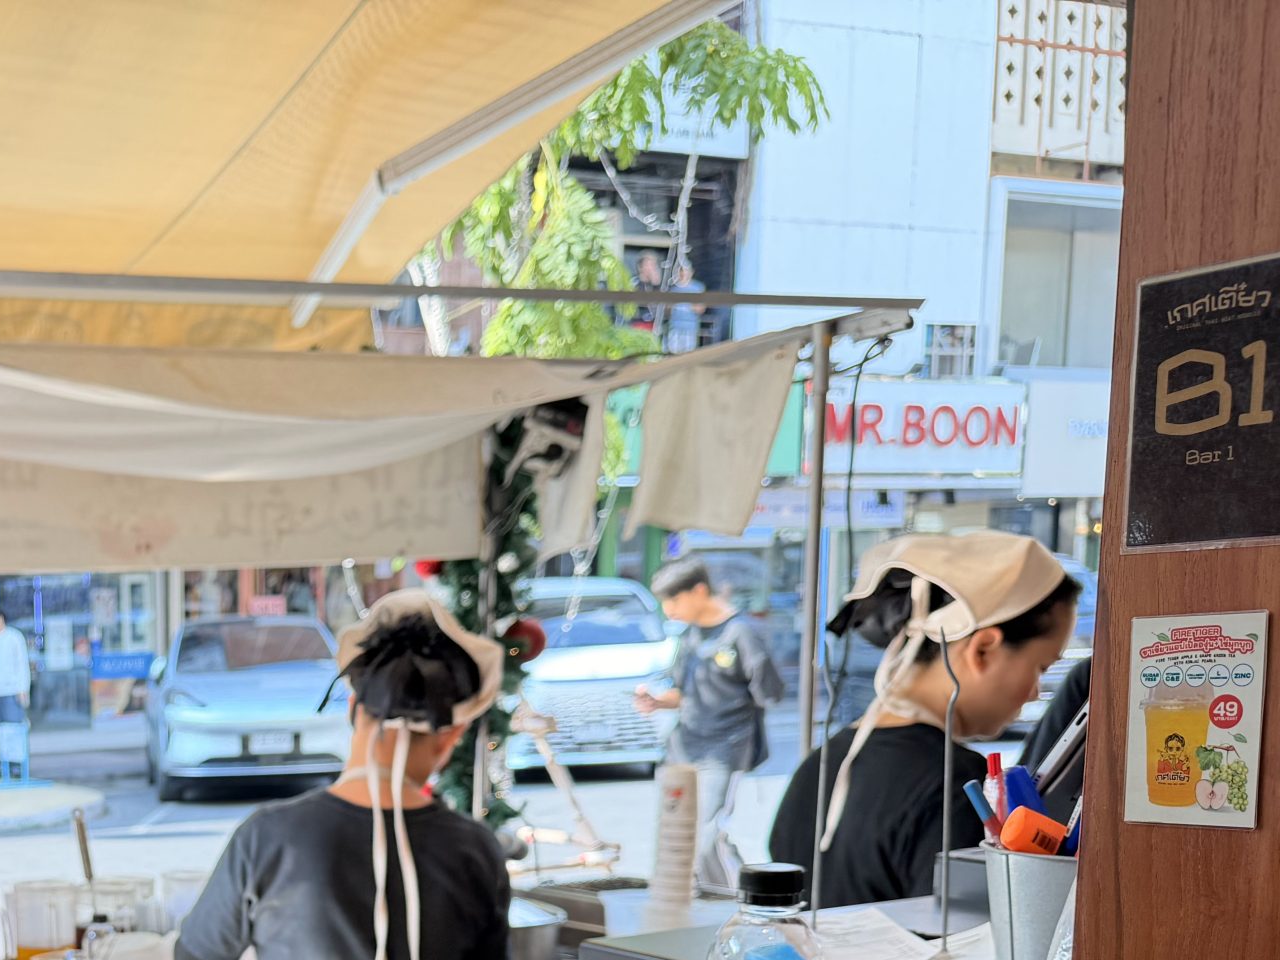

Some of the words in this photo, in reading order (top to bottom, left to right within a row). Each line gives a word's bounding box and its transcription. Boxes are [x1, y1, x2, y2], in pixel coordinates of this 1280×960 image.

[1167, 282, 1271, 325] เกศเตี๋ยว
[1155, 339, 1273, 436] B1
[1185, 449, 1221, 465] Bar
[1173, 629, 1194, 639] FIRE
[1194, 627, 1220, 638] TIGER
[1213, 701, 1238, 717] 49
